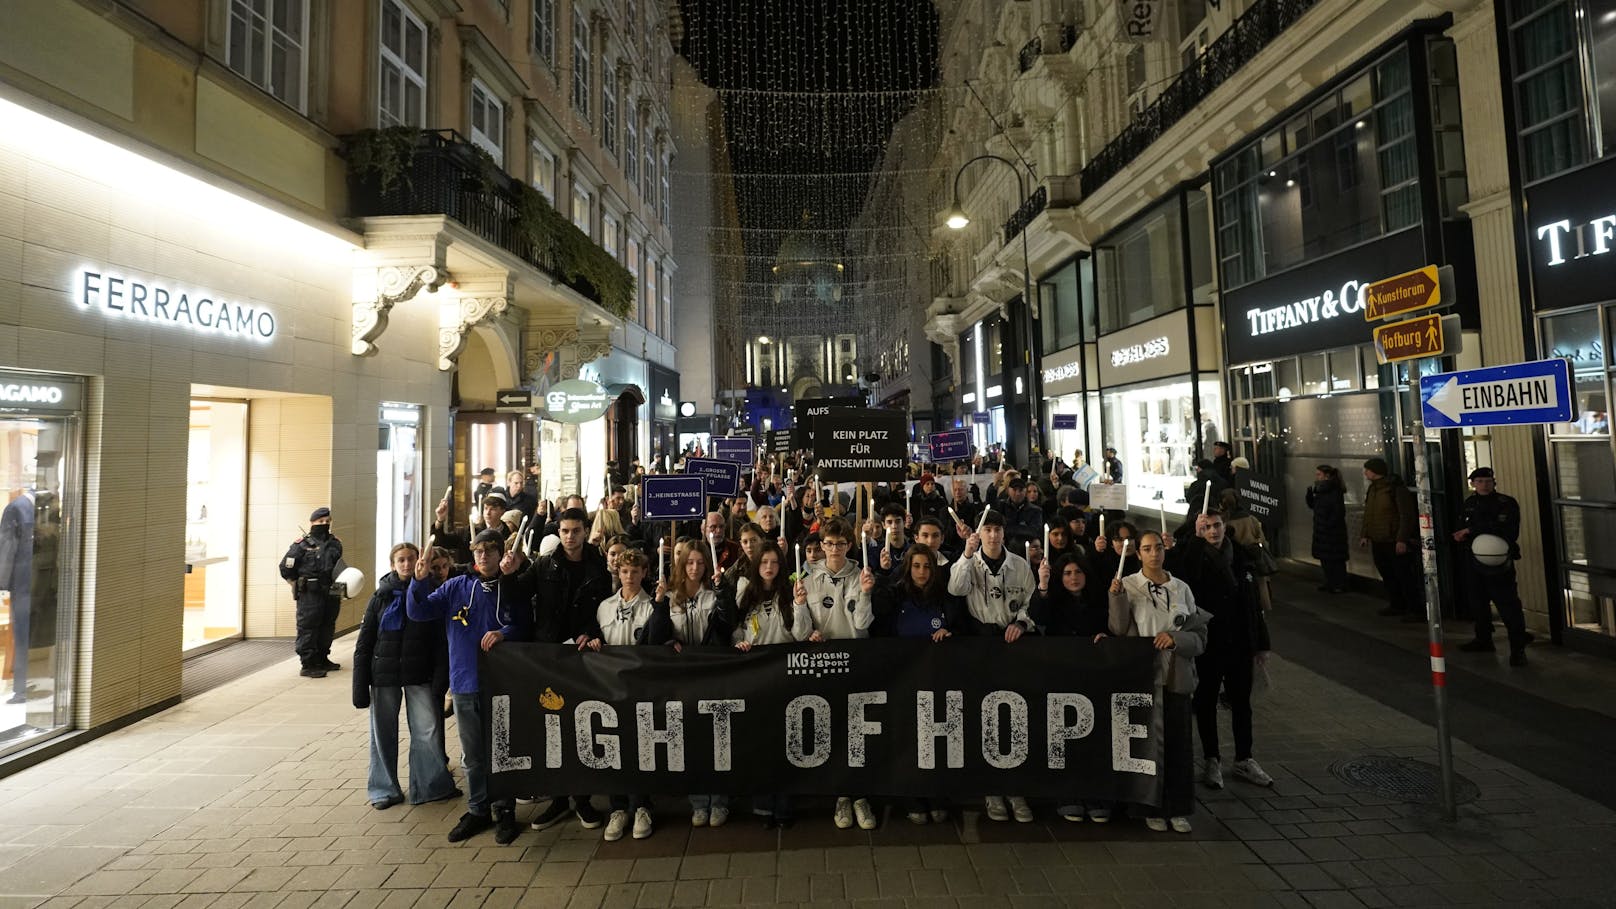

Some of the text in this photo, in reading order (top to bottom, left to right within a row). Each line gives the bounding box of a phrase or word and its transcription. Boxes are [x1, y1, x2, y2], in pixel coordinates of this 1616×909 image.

[1128, 0, 1151, 36] Re
[1377, 283, 1425, 305] Kunstforum
[84, 271, 274, 338] FERRAGAMO
[1247, 297, 1321, 335] TIFFANY
[1321, 289, 1339, 319] &
[1382, 331, 1422, 350] Hofburg
[1462, 380, 1548, 409] EINBAHN
[806, 407, 830, 416] AUFS
[833, 430, 888, 440] KEIN PLATZ
[850, 443, 871, 454] FÜR
[817, 458, 903, 469] ANTISEMITIMUS!
[1250, 480, 1269, 491] WANN
[1240, 488, 1278, 507] WENN NICHT
[1250, 503, 1269, 515] JETZT?
[787, 652, 850, 668] IKG JUGEND
[785, 691, 887, 768] OF
[916, 690, 1157, 776] HOPE
